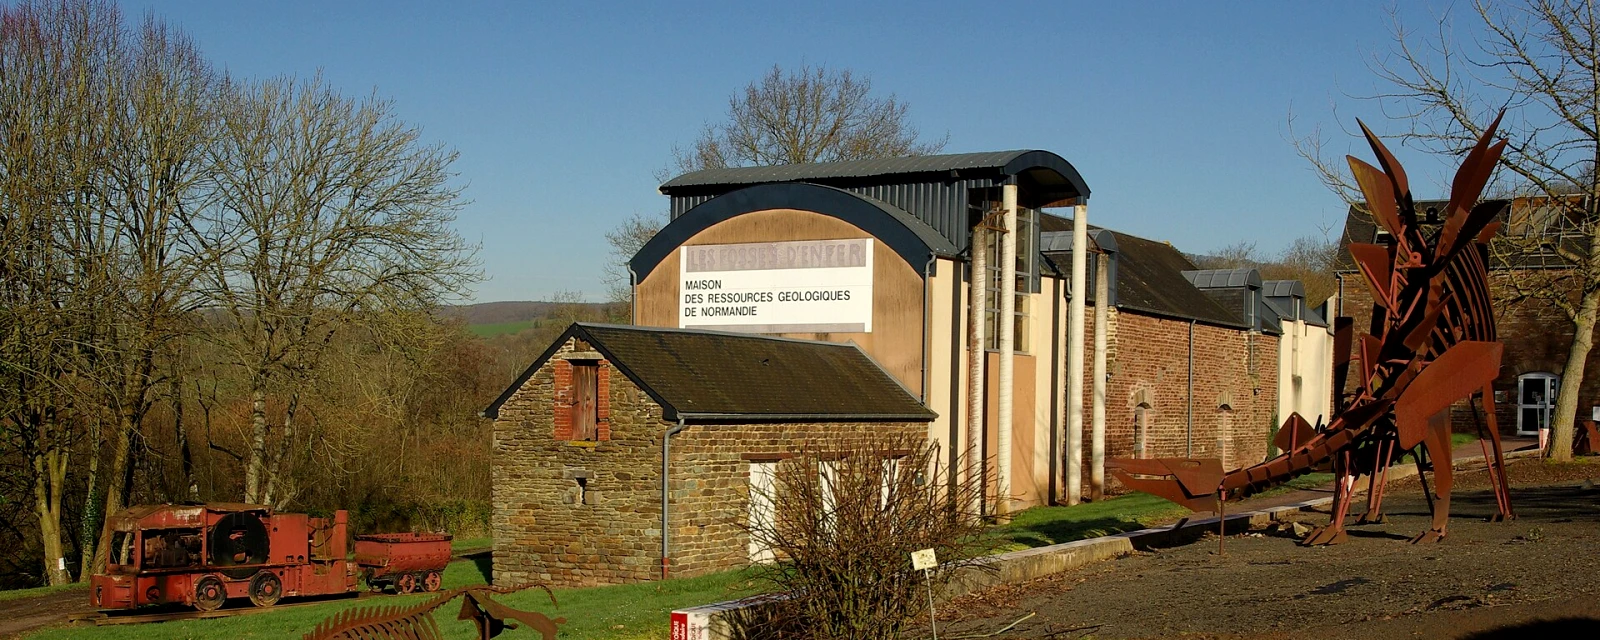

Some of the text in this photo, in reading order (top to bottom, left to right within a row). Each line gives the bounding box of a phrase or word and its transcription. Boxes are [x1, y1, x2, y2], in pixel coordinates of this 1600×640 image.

[690, 243, 861, 269] LES FOSSES D'ENFER
[685, 280, 722, 291] MAISON
[685, 290, 851, 304] DES RESSOURCES GEOLOGIQUES
[685, 306, 758, 317] DE NORMANDIE
